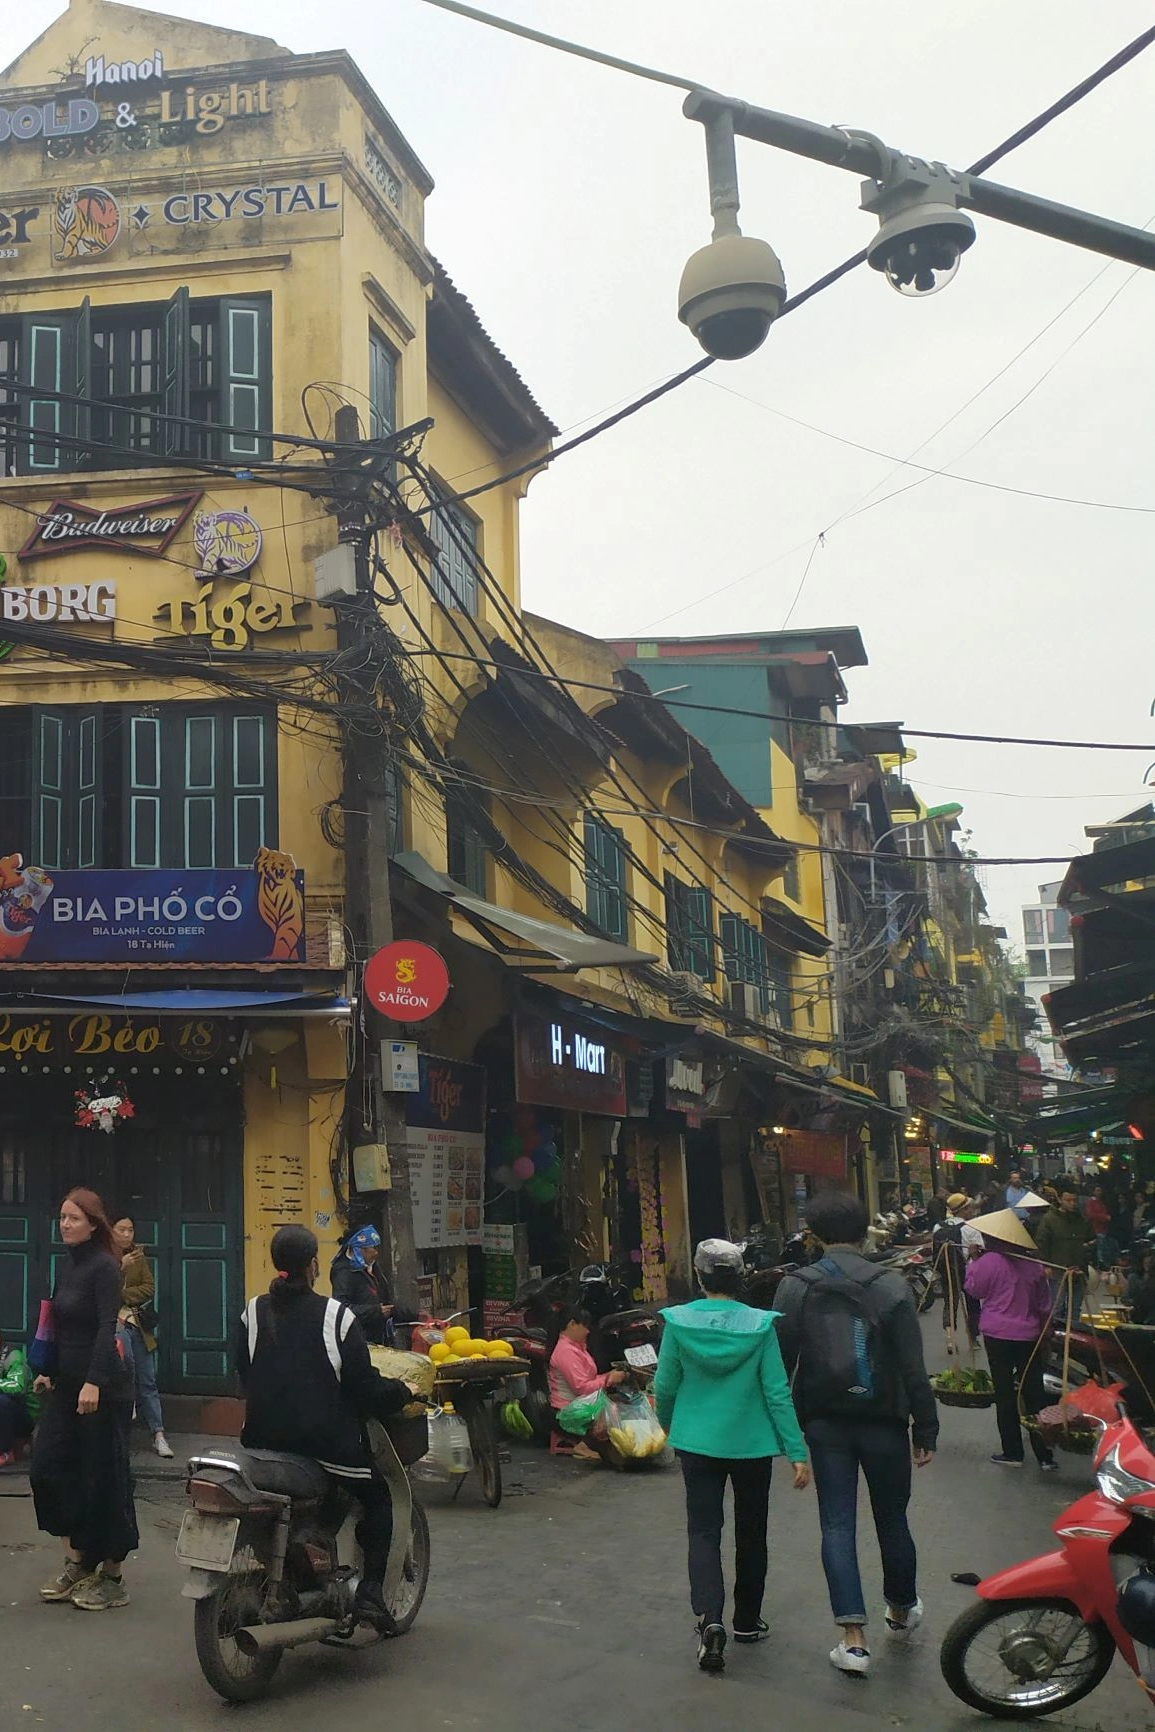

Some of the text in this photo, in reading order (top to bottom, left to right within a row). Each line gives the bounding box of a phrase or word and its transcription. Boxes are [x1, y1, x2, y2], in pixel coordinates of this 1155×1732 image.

[84, 49, 163, 87] Hanoi
[116, 101, 138, 129] &
[160, 78, 272, 134] Light
[163, 181, 339, 227] CRYSTAL
[36, 512, 179, 541] Budweiser
[157, 582, 301, 650] Tiger
[53, 884, 242, 922] BIA PHỐ CỔ
[92, 926, 110, 936] BIA
[147, 926, 176, 936] COLD
[177, 926, 206, 936] BEER
[378, 991, 429, 1008] SAIGON
[397, 986, 412, 995] BIA
[178, 1020, 214, 1047] 18
[551, 1023, 563, 1065] H
[574, 1033, 606, 1075] Mart
